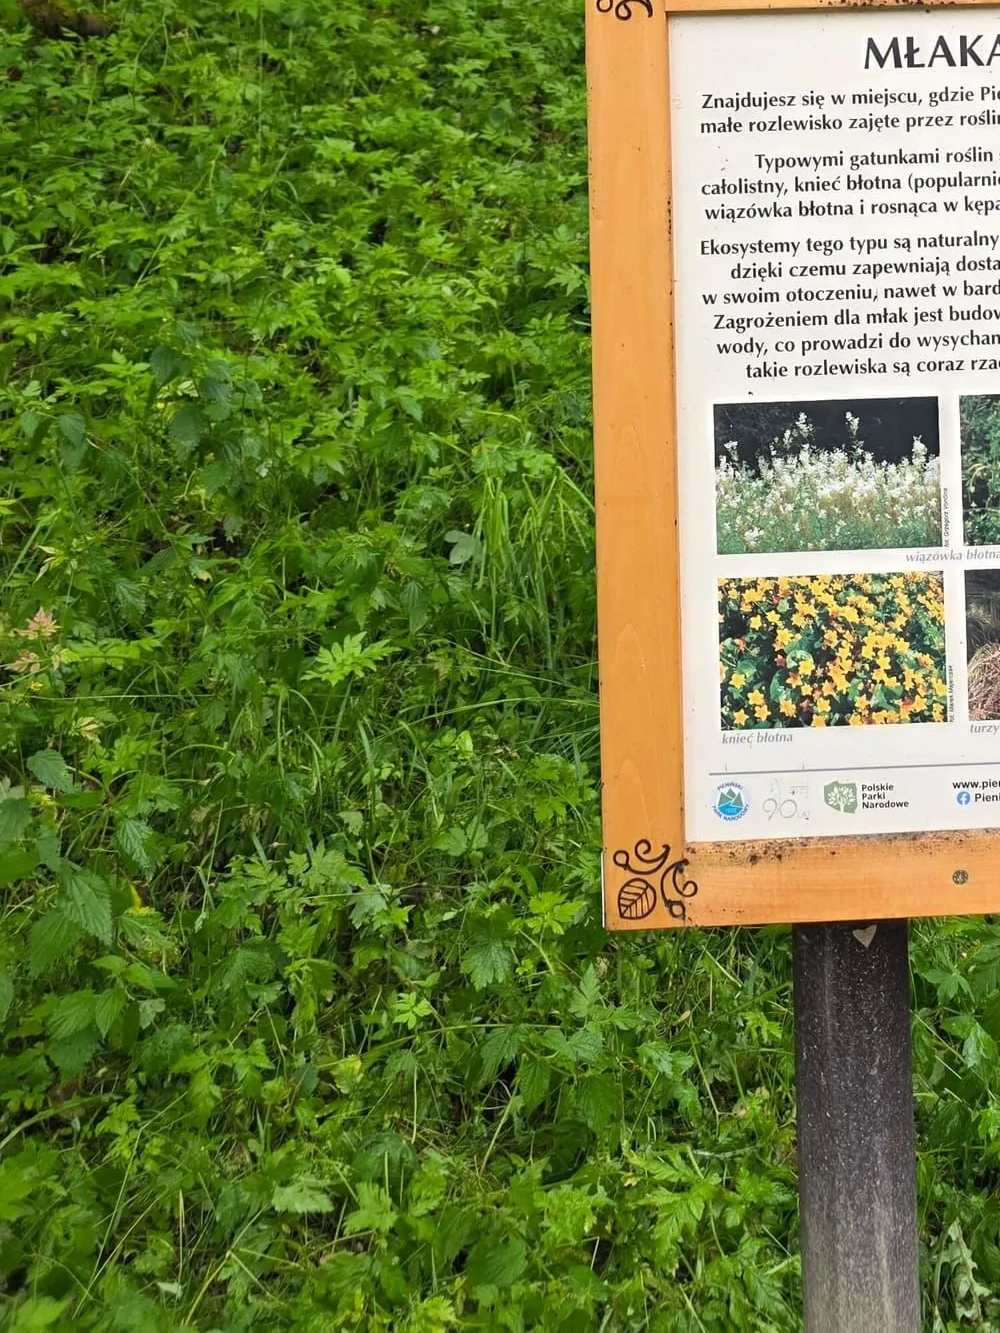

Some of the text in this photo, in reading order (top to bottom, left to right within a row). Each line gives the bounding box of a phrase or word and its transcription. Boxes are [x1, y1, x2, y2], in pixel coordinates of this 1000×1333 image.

[702, 92, 795, 111] Znajdujesz
[802, 91, 824, 109] się
[831, 95, 845, 104] w
[852, 89, 922, 107] miejscu,
[929, 86, 974, 107] gdzie
[701, 117, 742, 133] małe
[749, 114, 842, 132] rozlewisko
[849, 113, 899, 132] zajęte
[906, 116, 953, 132] przez
[755, 151, 843, 173] Typowymi
[850, 148, 939, 170] gatunkami
[947, 147, 993, 162] roślin
[702, 178, 788, 197] całolistny,
[795, 176, 840, 192] knieć
[847, 174, 901, 190] błotna
[705, 202, 792, 223] wiązówka
[799, 201, 853, 216] błotna
[860, 199, 864, 214] i
[871, 202, 937, 217] rosnąca
[944, 202, 958, 212] w
[701, 239, 800, 258] Ekosystemy
[806, 238, 843, 256] tego
[850, 237, 887, 255] typu
[894, 238, 911, 252] są
[731, 262, 782, 282] dzięki
[789, 265, 845, 277] czemu
[853, 257, 950, 279] zapewniają
[702, 294, 717, 304] w
[724, 287, 779, 304] swoim
[786, 284, 878, 302] otoczeniu,
[884, 284, 936, 298] nawet
[943, 286, 957, 296] w
[714, 311, 827, 333] Zagrożeniem
[834, 309, 860, 325] dla
[867, 307, 908, 324] młak
[914, 307, 943, 326] jest
[717, 337, 768, 358] wody,
[775, 341, 795, 352] co
[802, 334, 882, 356] prowadzi
[889, 332, 910, 348] do
[746, 362, 788, 378] takie
[795, 358, 887, 376] rozlewiska
[893, 362, 910, 376] są
[917, 360, 964, 372] coraz
[906, 550, 963, 563] wiązówka
[722, 732, 793, 745] knieć błotna
[862, 783, 894, 791] Polskie
[862, 792, 885, 800] Parki
[863, 800, 909, 809] Narodowe
